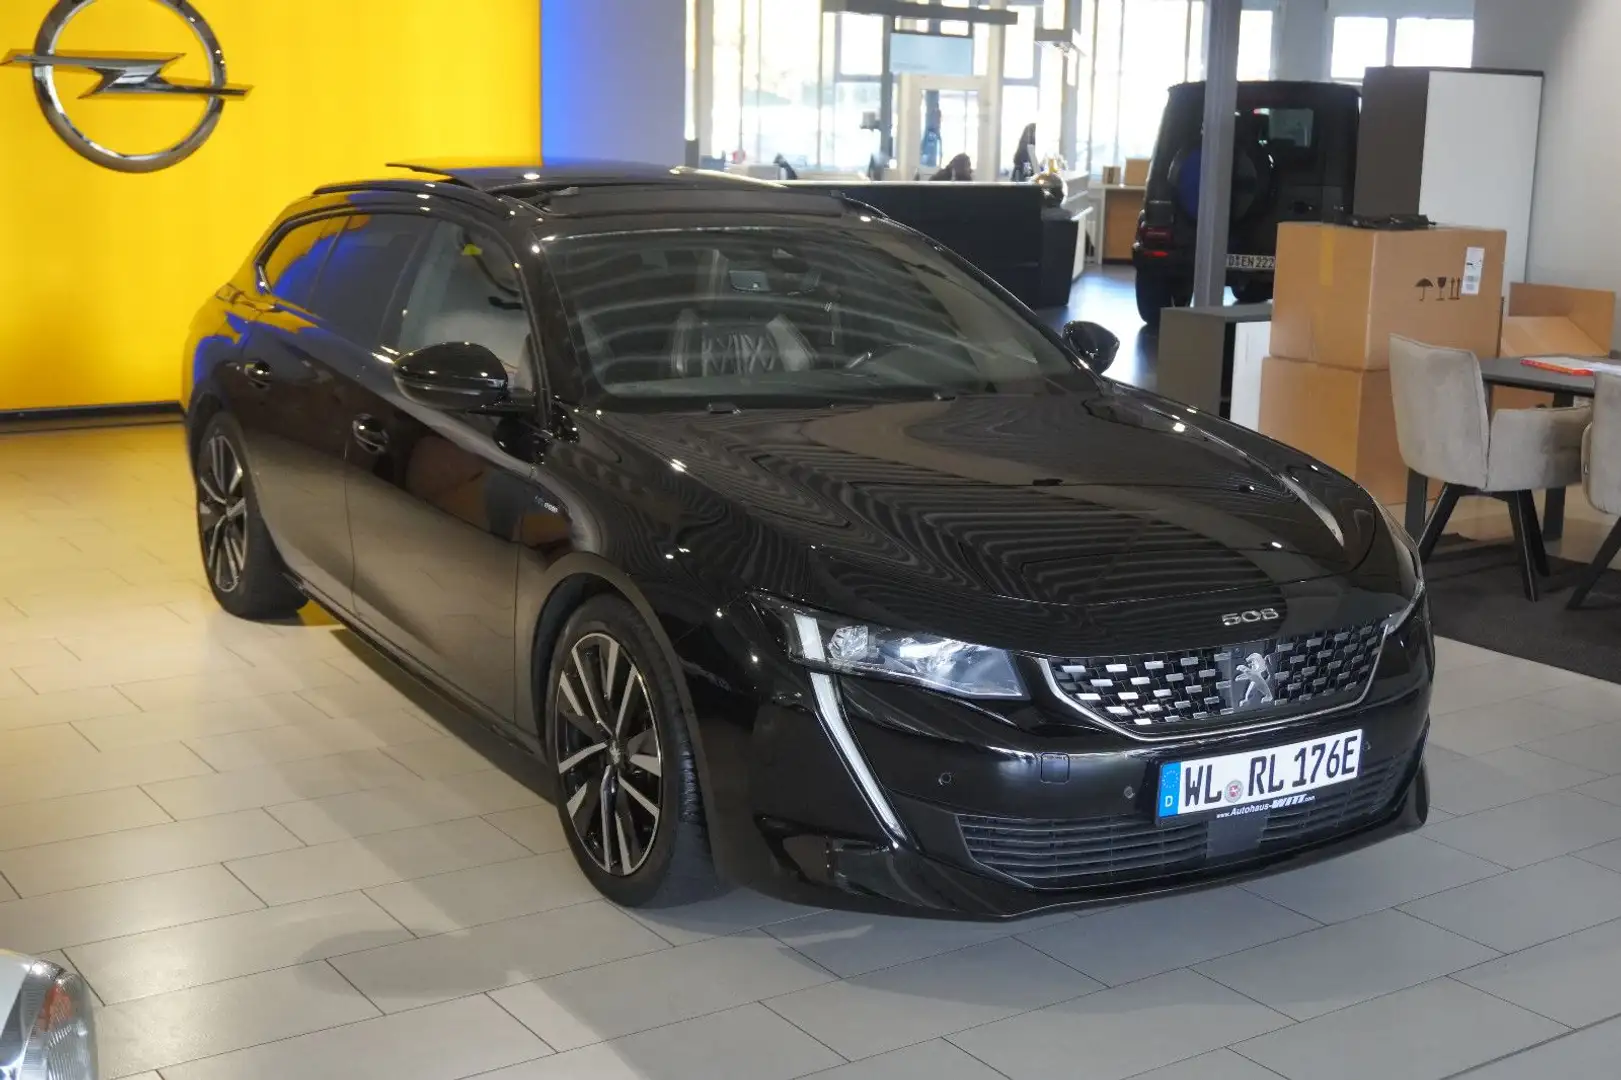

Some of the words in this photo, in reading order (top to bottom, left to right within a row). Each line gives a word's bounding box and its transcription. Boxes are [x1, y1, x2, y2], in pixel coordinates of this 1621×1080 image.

[1222, 607, 1279, 626] 508
[1165, 795, 1173, 807] D
[1185, 764, 1222, 807] WL
[1248, 753, 1285, 797] RL
[1292, 735, 1358, 788] 176E
